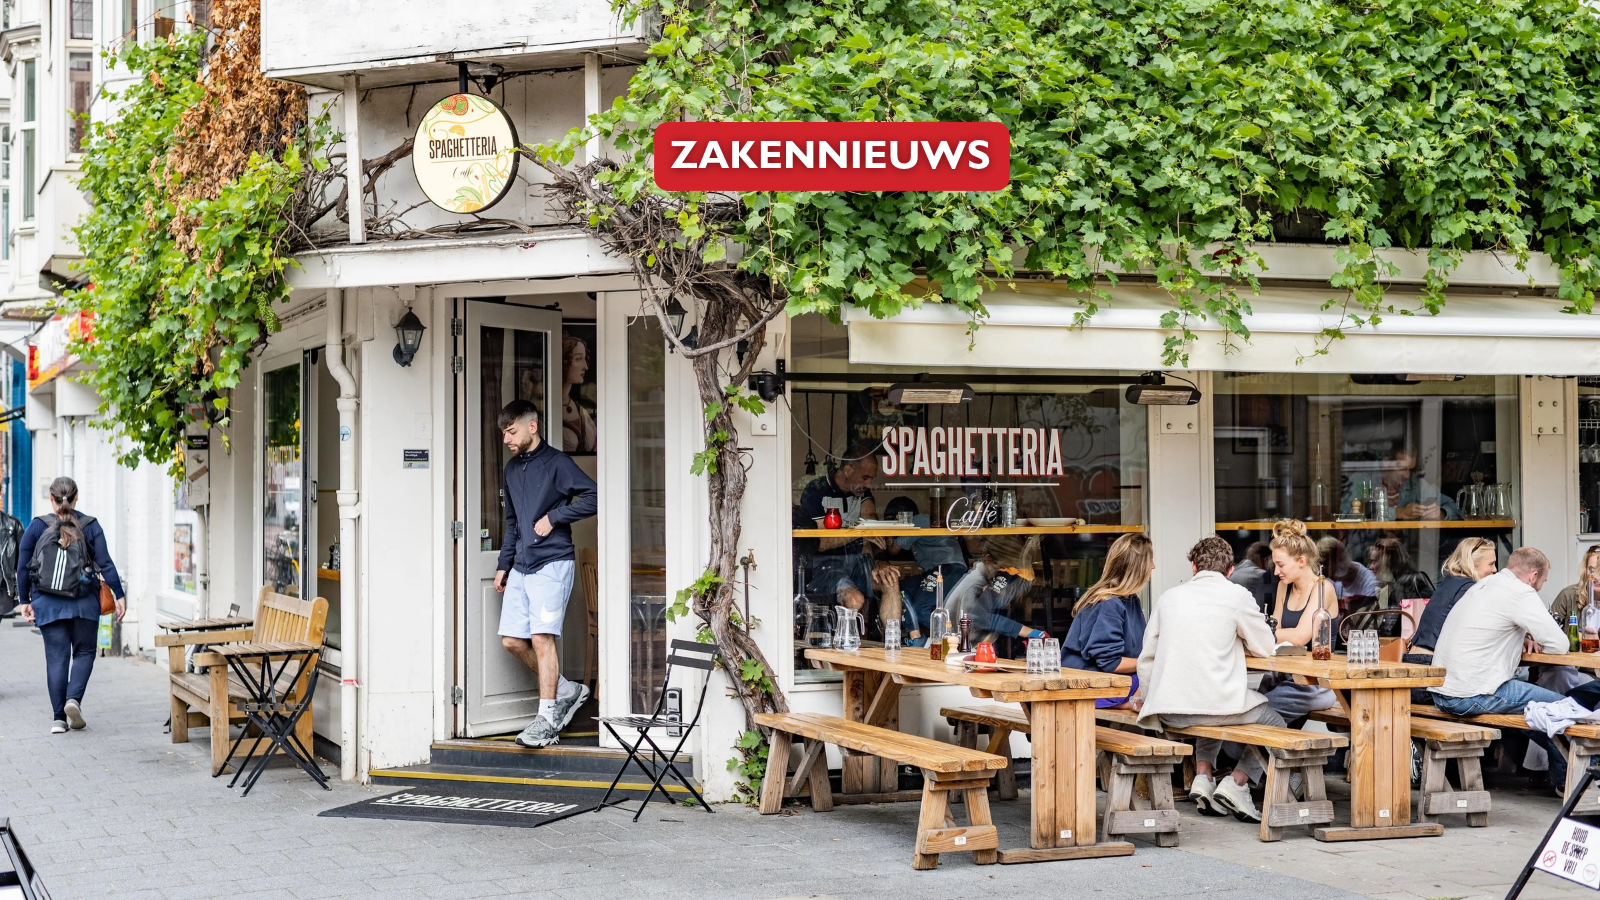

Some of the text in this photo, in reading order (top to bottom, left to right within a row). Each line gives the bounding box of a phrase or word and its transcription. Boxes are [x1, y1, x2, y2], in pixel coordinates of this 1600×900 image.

[429, 136, 498, 159] SPAGHETTERIA
[882, 426, 1065, 477] SPAGHETTERIA
[946, 496, 998, 534] Caffè
[375, 792, 579, 814] SPAGHETTERIA
[1571, 826, 1589, 844] HOUD
[1561, 840, 1571, 855] DE
[1563, 859, 1578, 875] VRIJ
